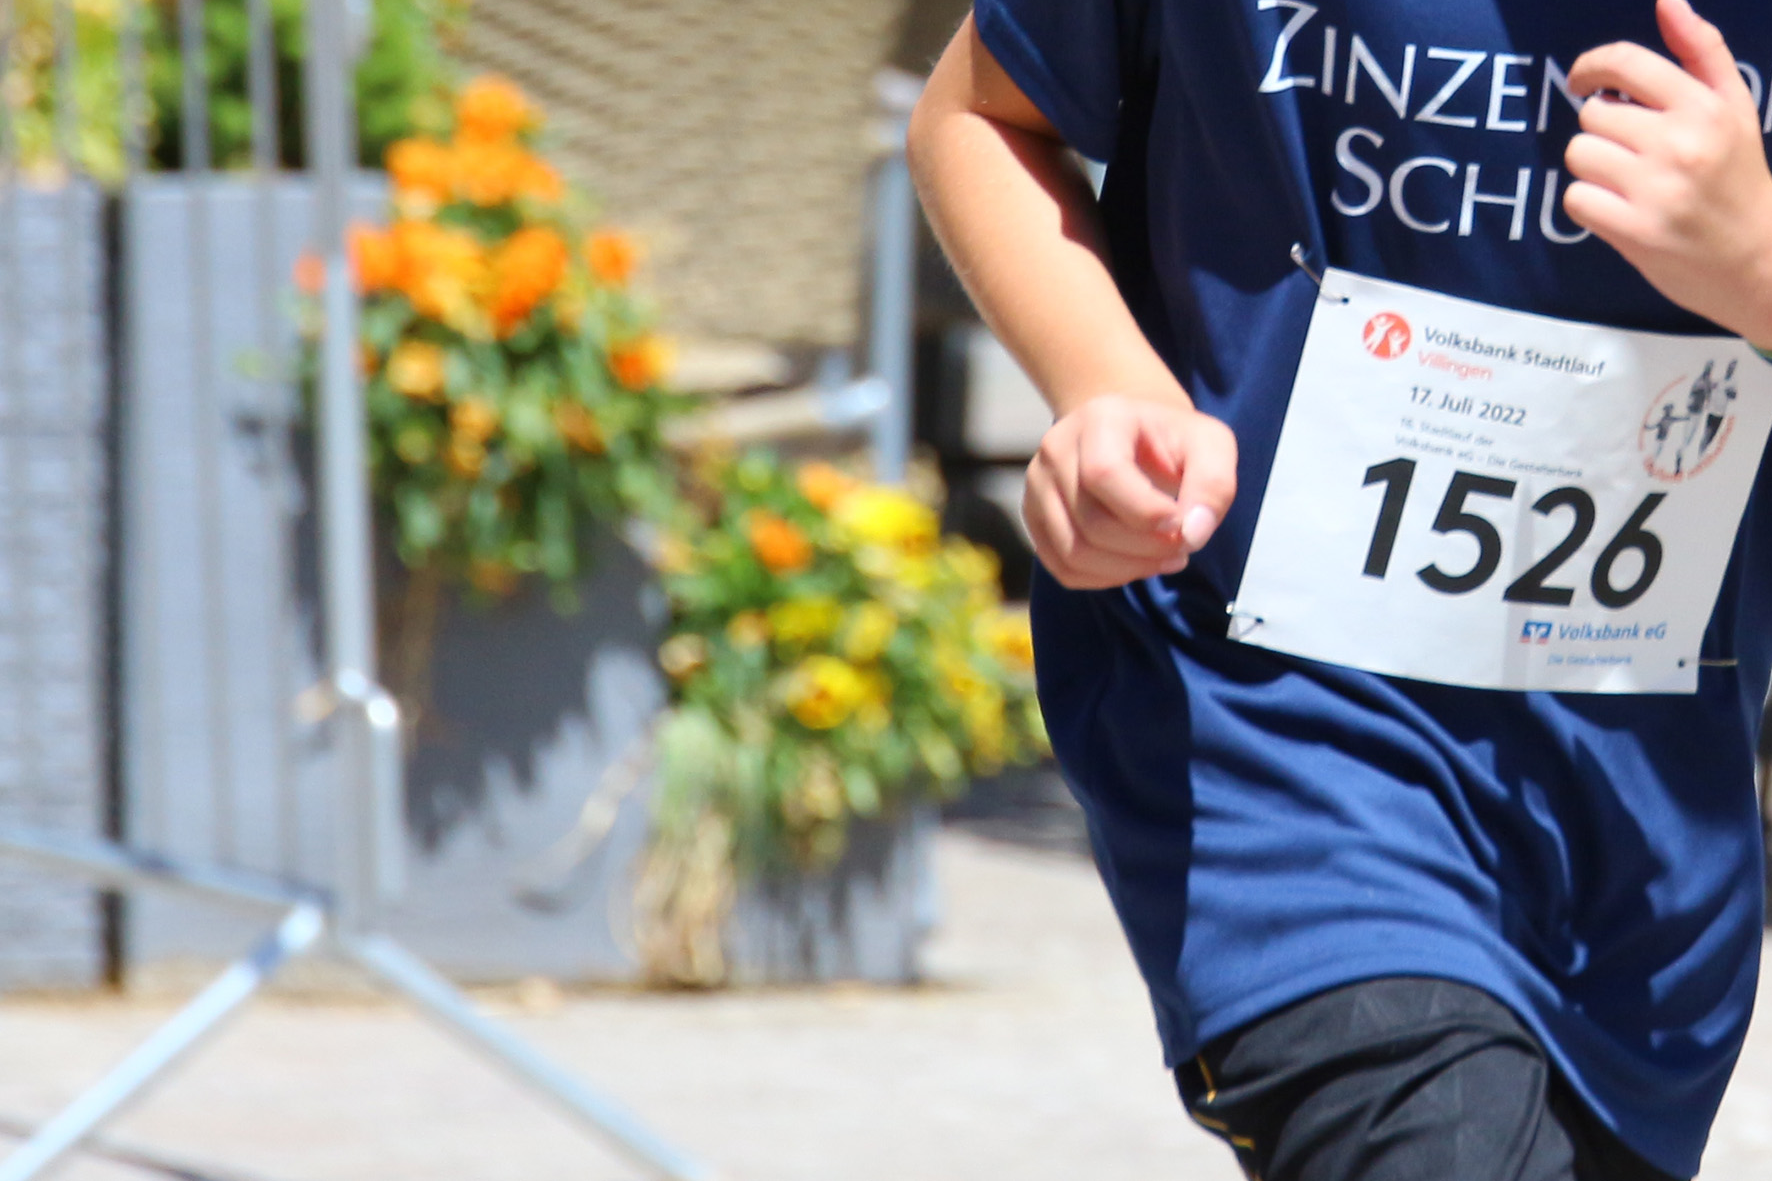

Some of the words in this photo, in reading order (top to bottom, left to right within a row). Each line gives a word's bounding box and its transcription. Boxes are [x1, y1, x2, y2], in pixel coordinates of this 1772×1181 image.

[1330, 127, 1592, 244] SCHU
[1417, 351, 1495, 382] Villingen
[1424, 326, 1518, 362] Volksbank
[1522, 350, 1606, 378] Stadtlauf
[1409, 386, 1433, 409] 17.
[1438, 392, 1475, 416] Juli
[1478, 403, 1528, 427] 2022
[1361, 456, 1668, 609] 1526
[1559, 622, 1640, 641] Volksbank
[1644, 622, 1668, 640] eG
